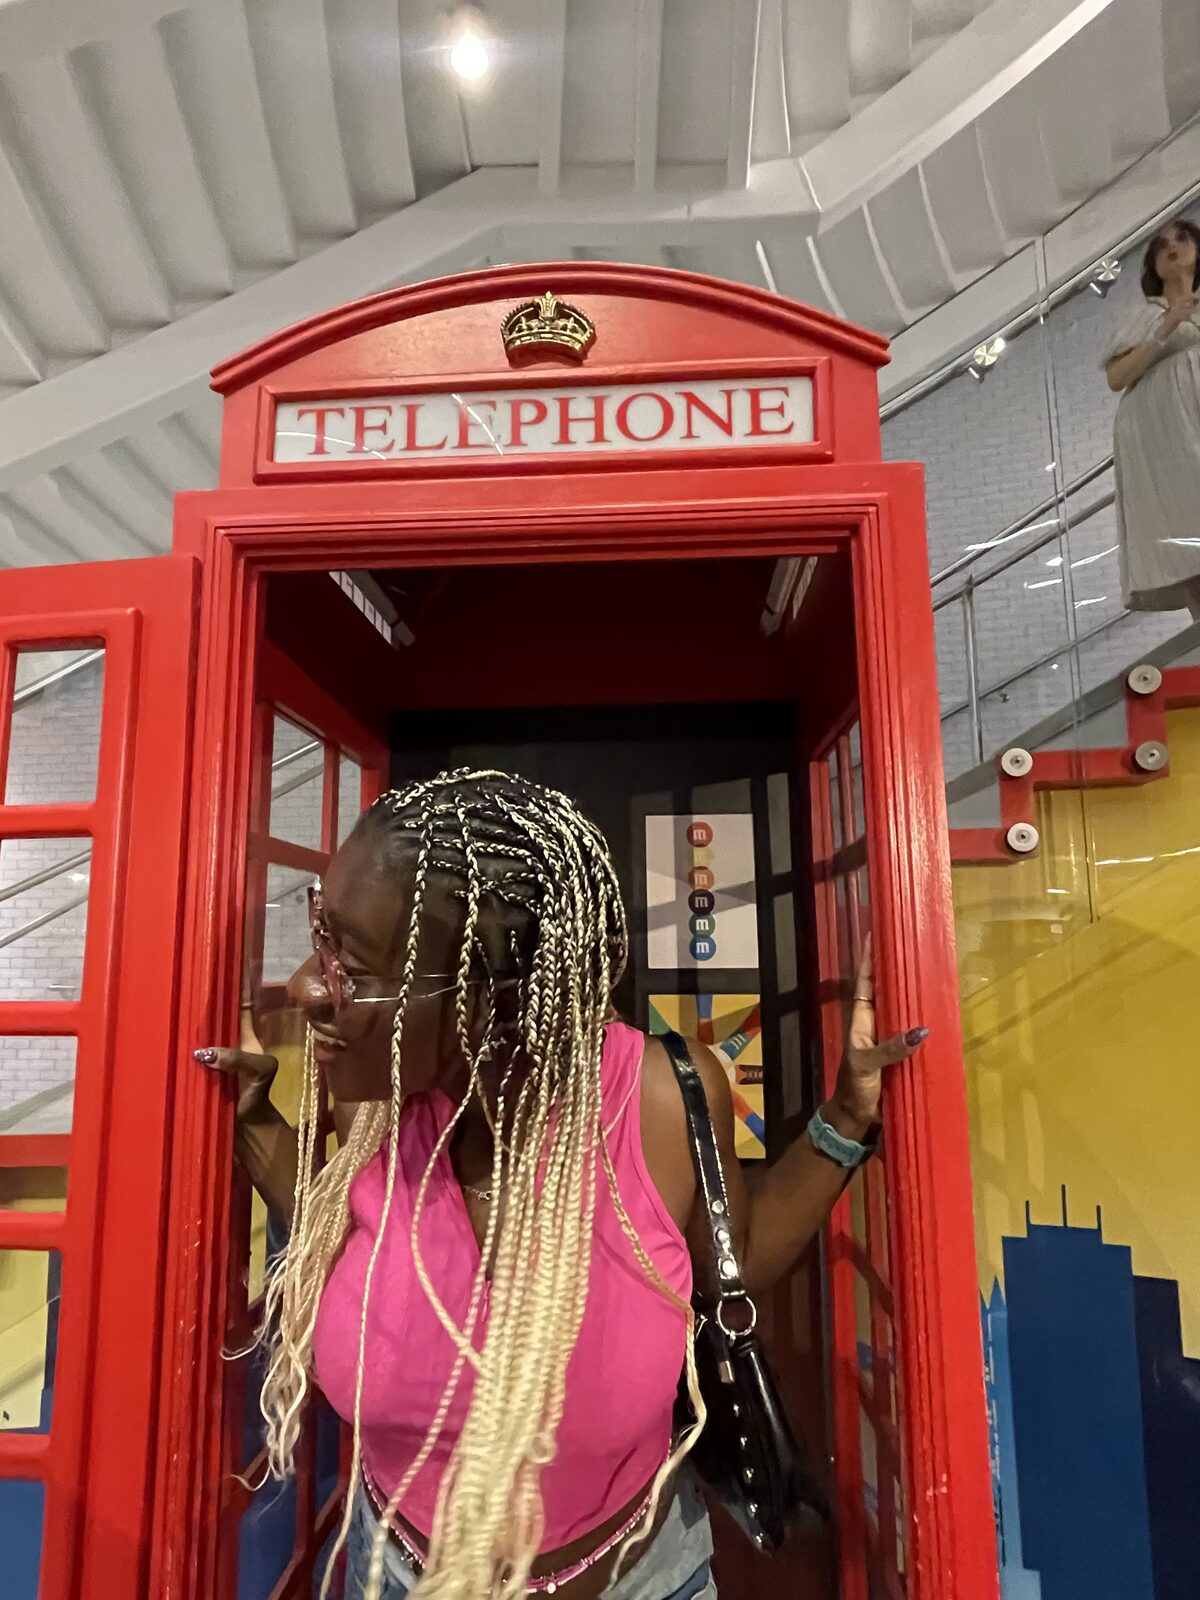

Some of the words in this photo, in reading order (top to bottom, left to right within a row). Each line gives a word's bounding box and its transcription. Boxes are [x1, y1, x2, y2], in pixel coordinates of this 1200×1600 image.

[297, 386, 795, 455] TELEPHONE
[693, 829, 706, 840] m
[694, 874, 708, 885] m
[695, 897, 708, 908] m
[696, 919, 709, 930] m
[696, 942, 710, 953] m
